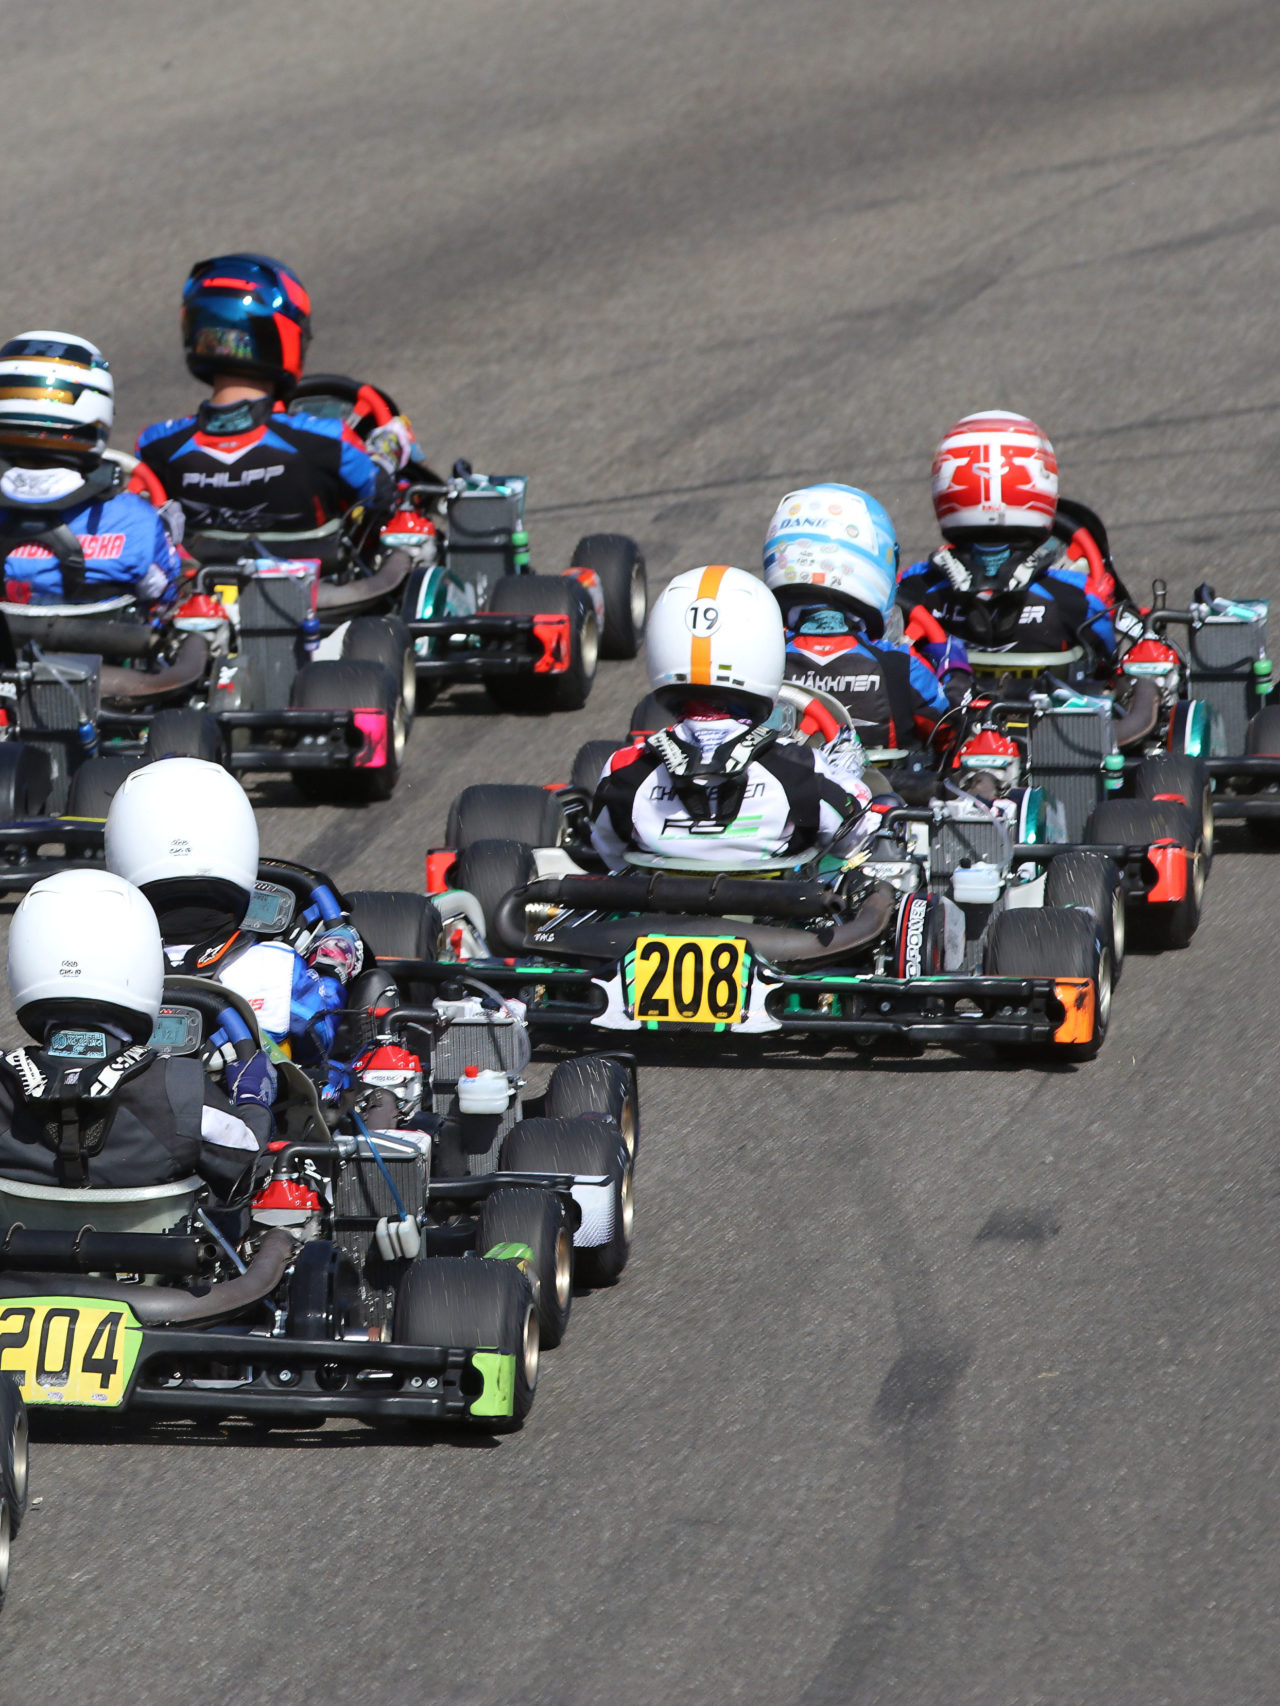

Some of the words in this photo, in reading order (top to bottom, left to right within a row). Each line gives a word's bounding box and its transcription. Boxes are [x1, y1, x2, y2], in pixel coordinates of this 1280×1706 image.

[182, 464, 285, 488] PHILIPP
[690, 606, 719, 630] 19
[638, 941, 739, 1019] 208
